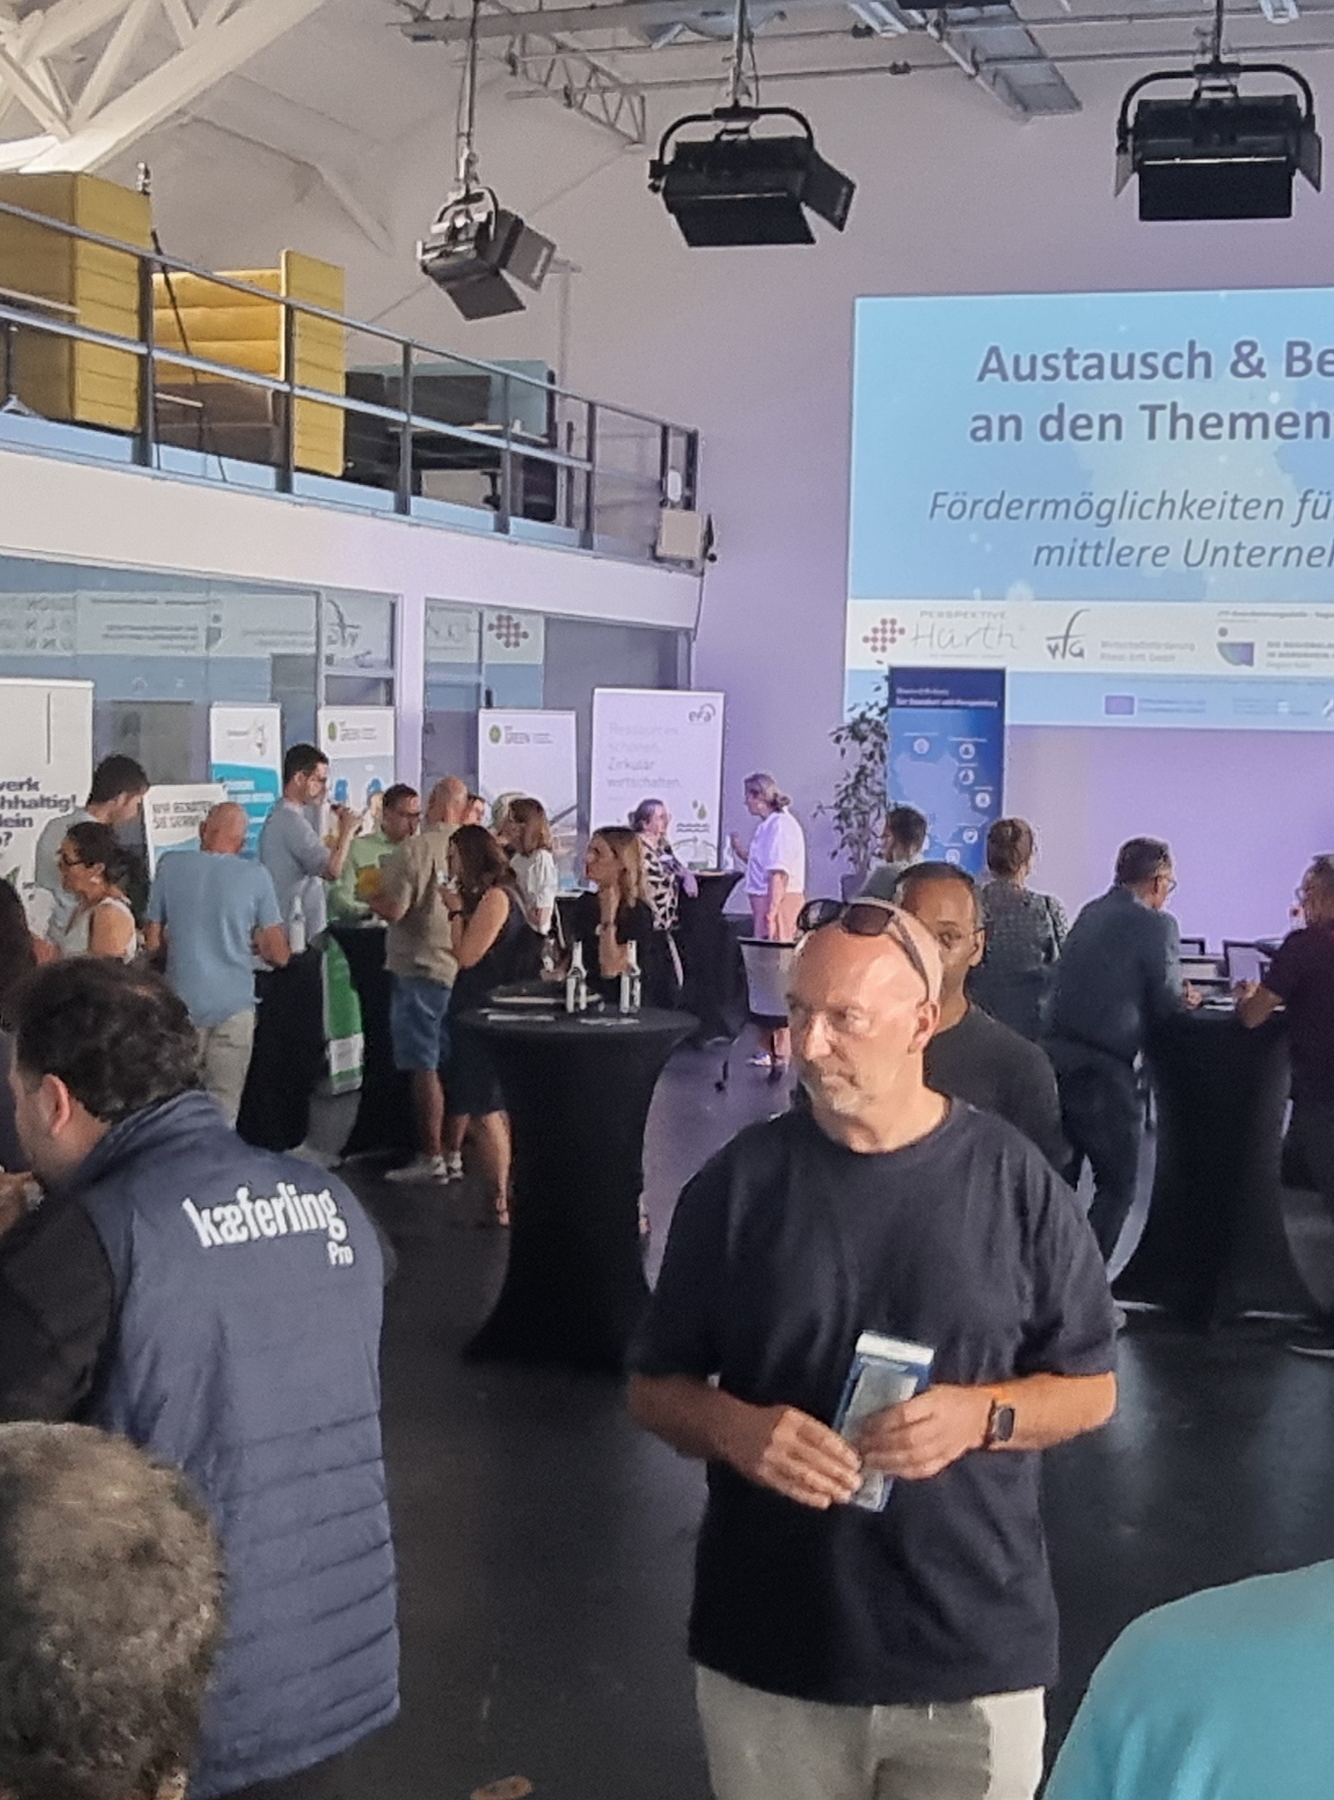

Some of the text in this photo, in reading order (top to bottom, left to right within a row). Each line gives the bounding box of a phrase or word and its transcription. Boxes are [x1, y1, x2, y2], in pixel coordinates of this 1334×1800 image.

[976, 338, 1213, 383] Austausch
[1229, 339, 1267, 379] &
[969, 413, 1023, 443] an
[1038, 402, 1123, 442] den
[928, 489, 1284, 528] Fördermöglichkeiten
[1033, 537, 1170, 568] mittlere
[327, 1241, 355, 1266] Pro
